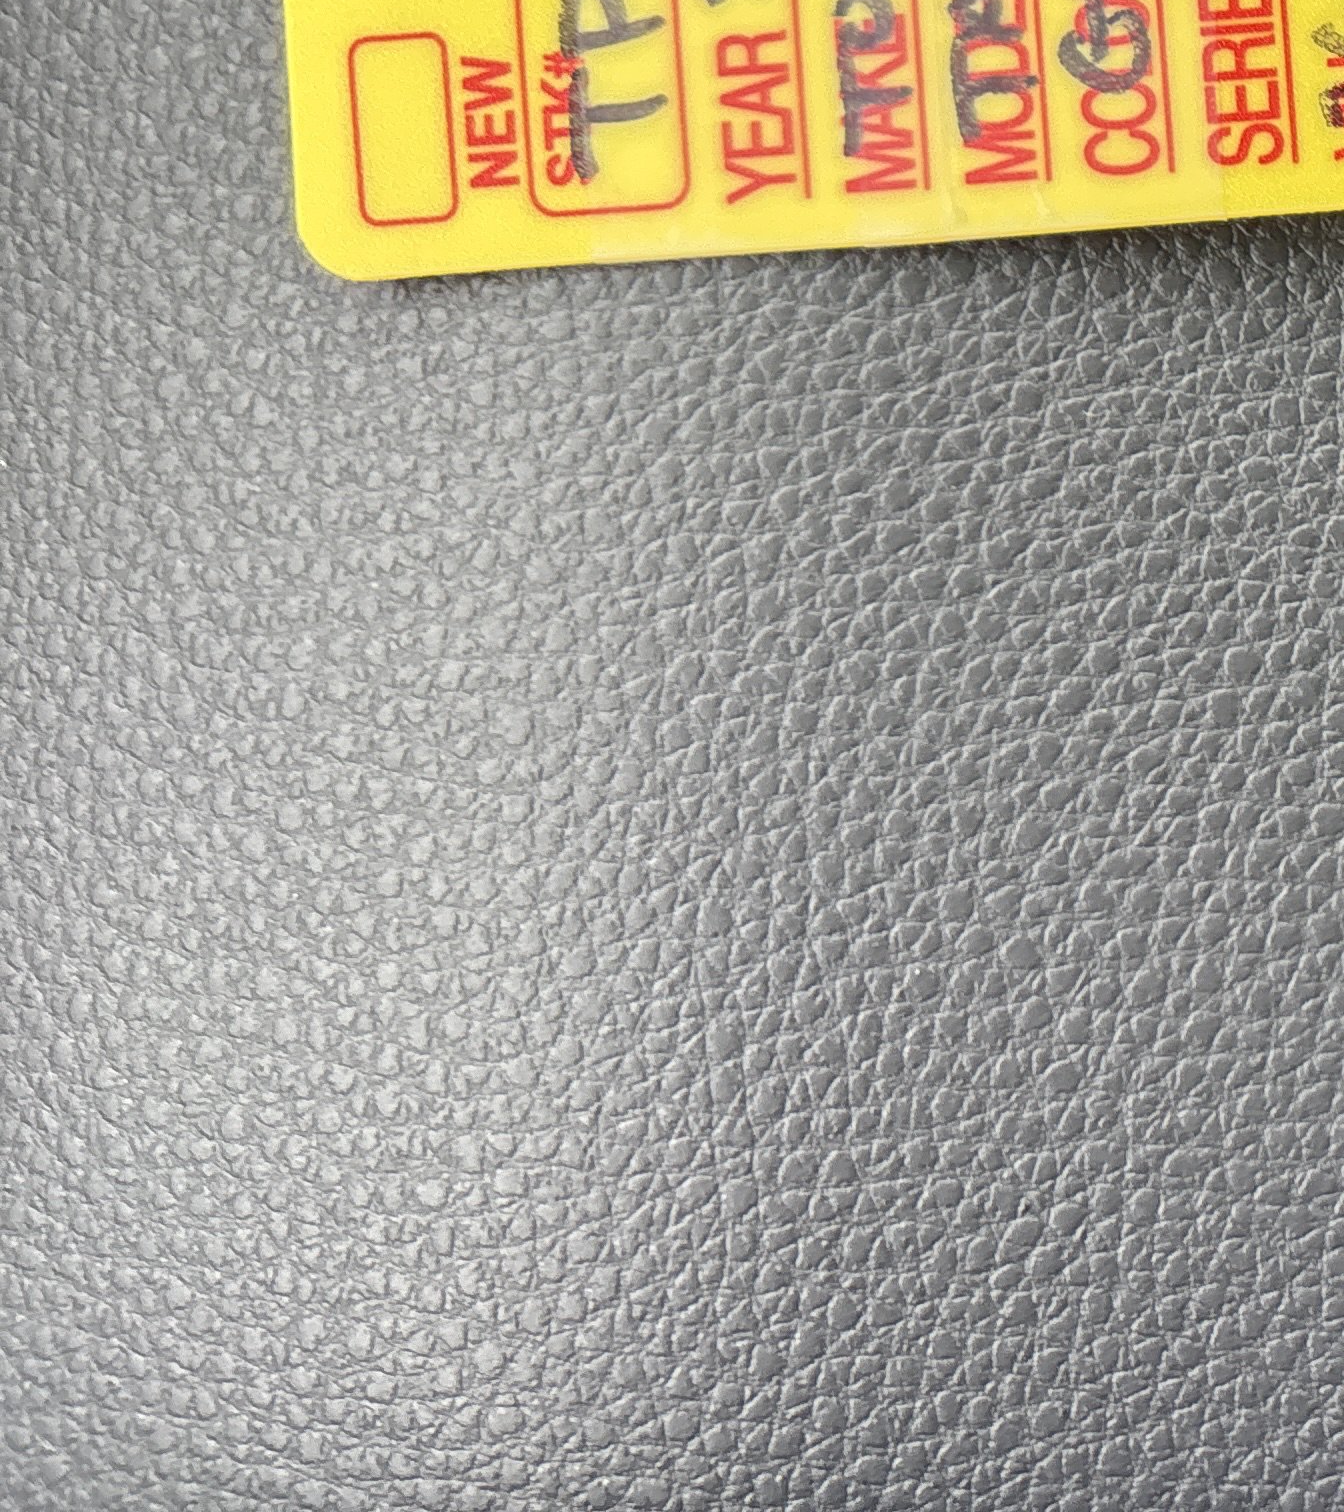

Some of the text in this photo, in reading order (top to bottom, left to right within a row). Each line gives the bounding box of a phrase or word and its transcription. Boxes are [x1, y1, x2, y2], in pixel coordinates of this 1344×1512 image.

[460, 56, 521, 190] NEW
[716, 30, 797, 205] YEAR
[833, 12, 917, 194] MAKE
